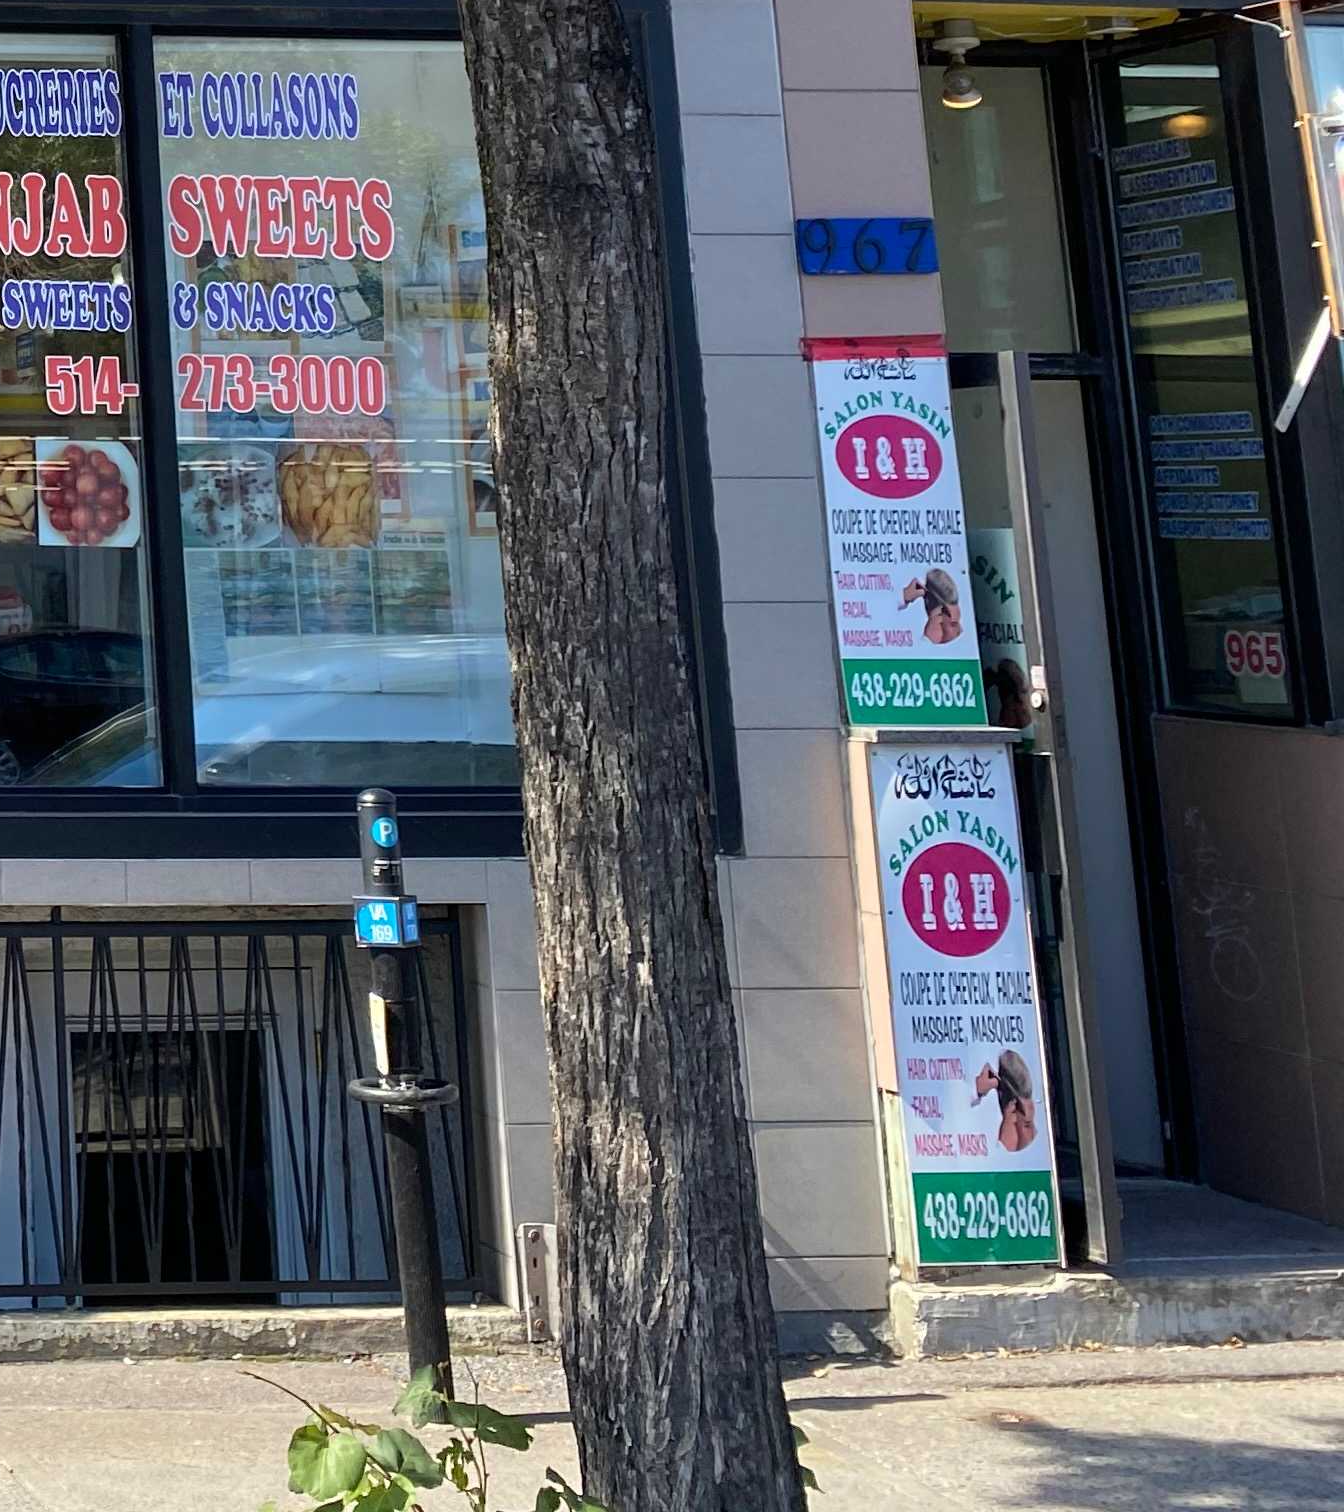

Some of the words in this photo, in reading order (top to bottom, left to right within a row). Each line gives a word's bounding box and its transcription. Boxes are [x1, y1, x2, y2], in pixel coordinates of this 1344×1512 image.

[158, 72, 194, 140] ET
[201, 72, 360, 141] COLLASONS
[167, 174, 395, 261] SWEETS
[804, 218, 932, 274] 967
[1, 280, 132, 332] SWEETS
[172, 283, 198, 332] &
[204, 282, 337, 334] SNACKS
[44, 354, 140, 415] 514-
[177, 354, 387, 416] 273-3000
[824, 390, 883, 440] SALON
[891, 390, 951, 440] YASIN
[876, 436, 898, 481] &
[831, 509, 865, 535] COUPE
[865, 509, 878, 535] DE
[926, 509, 962, 535] FACIALE
[842, 542, 898, 565] MASSAGE,
[900, 542, 953, 566] MASQUES
[836, 573, 857, 590] HAIR
[884, 630, 913, 648] MASKS
[1226, 632, 1284, 677] 965
[851, 672, 976, 708] 438-229-6862
[889, 810, 949, 877] SALON
[956, 810, 1019, 875] YASIN
[368, 903, 388, 921] VA
[919, 874, 937, 931] I
[943, 872, 966, 931] &
[969, 874, 999, 931] H
[370, 924, 393, 942] 169
[900, 972, 932, 1006] COUPE
[933, 972, 947, 1006] DE
[997, 971, 1033, 1005] FACIALE
[912, 1016, 968, 1046] MASSAGE,
[970, 1015, 1025, 1046] MASQUES
[907, 1058, 928, 1080] HAIR
[958, 1134, 989, 1157] MASKS
[924, 1191, 1051, 1240] 438-229-6862
